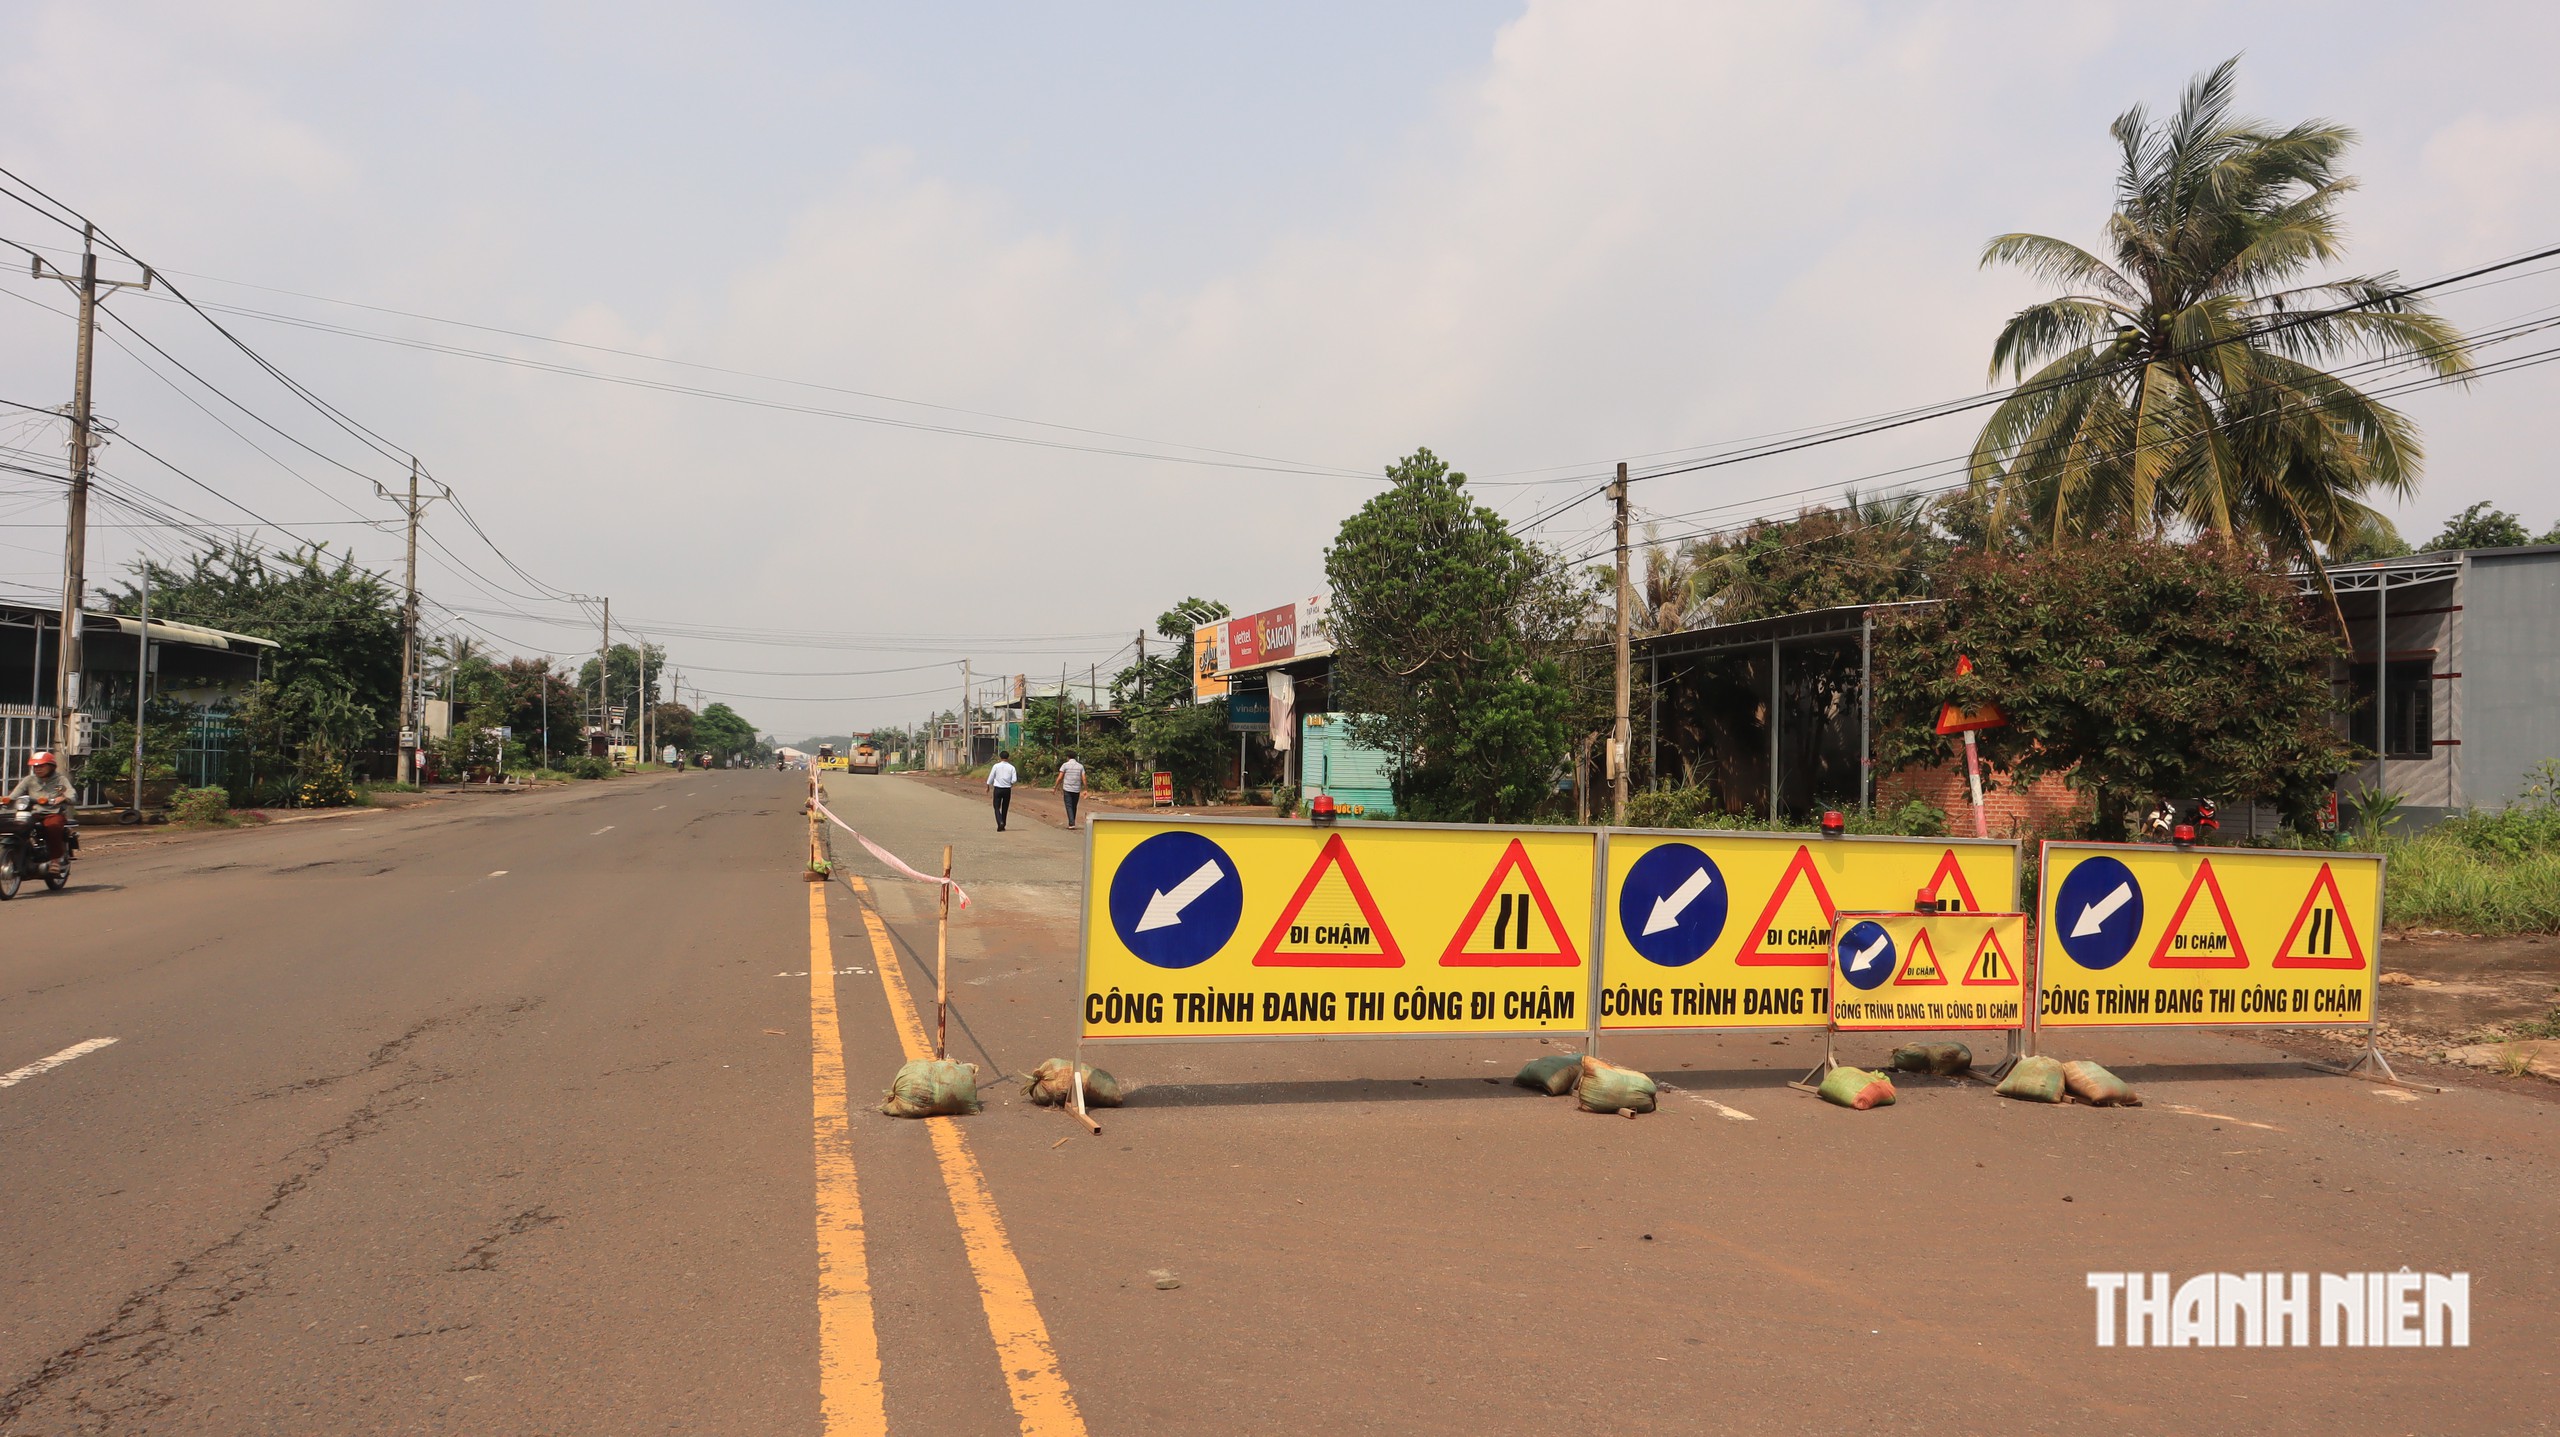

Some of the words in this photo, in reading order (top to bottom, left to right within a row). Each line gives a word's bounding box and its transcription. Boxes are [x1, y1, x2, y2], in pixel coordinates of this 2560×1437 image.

[1233, 629, 1252, 646] viettel
[1265, 623, 1294, 650] SAIGON
[1235, 703, 1270, 714] vinapho
[1290, 926, 1309, 944] ĐI
[1315, 923, 1370, 948] CHẬM
[1767, 929, 1783, 945] ĐI
[1788, 926, 1831, 949] CHẬM
[2175, 934, 2187, 949] ĐI
[2191, 932, 2227, 953] CHẬM
[1085, 986, 1164, 1024] CÔNG
[1173, 986, 1254, 1023] TRÌNH
[1262, 992, 1336, 1022] ĐANG
[1345, 992, 1385, 1021] THI
[1394, 985, 1463, 1021] CÔNG
[1470, 991, 1496, 1020] ĐI
[1504, 985, 1575, 1026] CHẬM
[1600, 983, 1663, 1016] CÔNG
[1670, 983, 1737, 1015] TRÌNH
[1743, 988, 1803, 1015] ĐANG
[1835, 1000, 1861, 1019] CÔNG
[1864, 1000, 1895, 1019] TRÌNH
[1897, 1003, 1925, 1019] ĐANG
[1927, 1003, 1944, 1019] THI
[1946, 1000, 1973, 1019] CÔNG
[1976, 1003, 1986, 1019] ĐI
[1990, 1000, 2018, 1022] CHẬM
[2041, 984, 2089, 1015] CÔNG
[2096, 984, 2149, 1014] TRÌNH
[2155, 989, 2203, 1013] ĐANG
[2209, 989, 2236, 1013] THI
[2241, 984, 2287, 1013] CÔNG
[2292, 988, 2309, 1012] ĐI
[2314, 984, 2362, 1018] CHẬM
